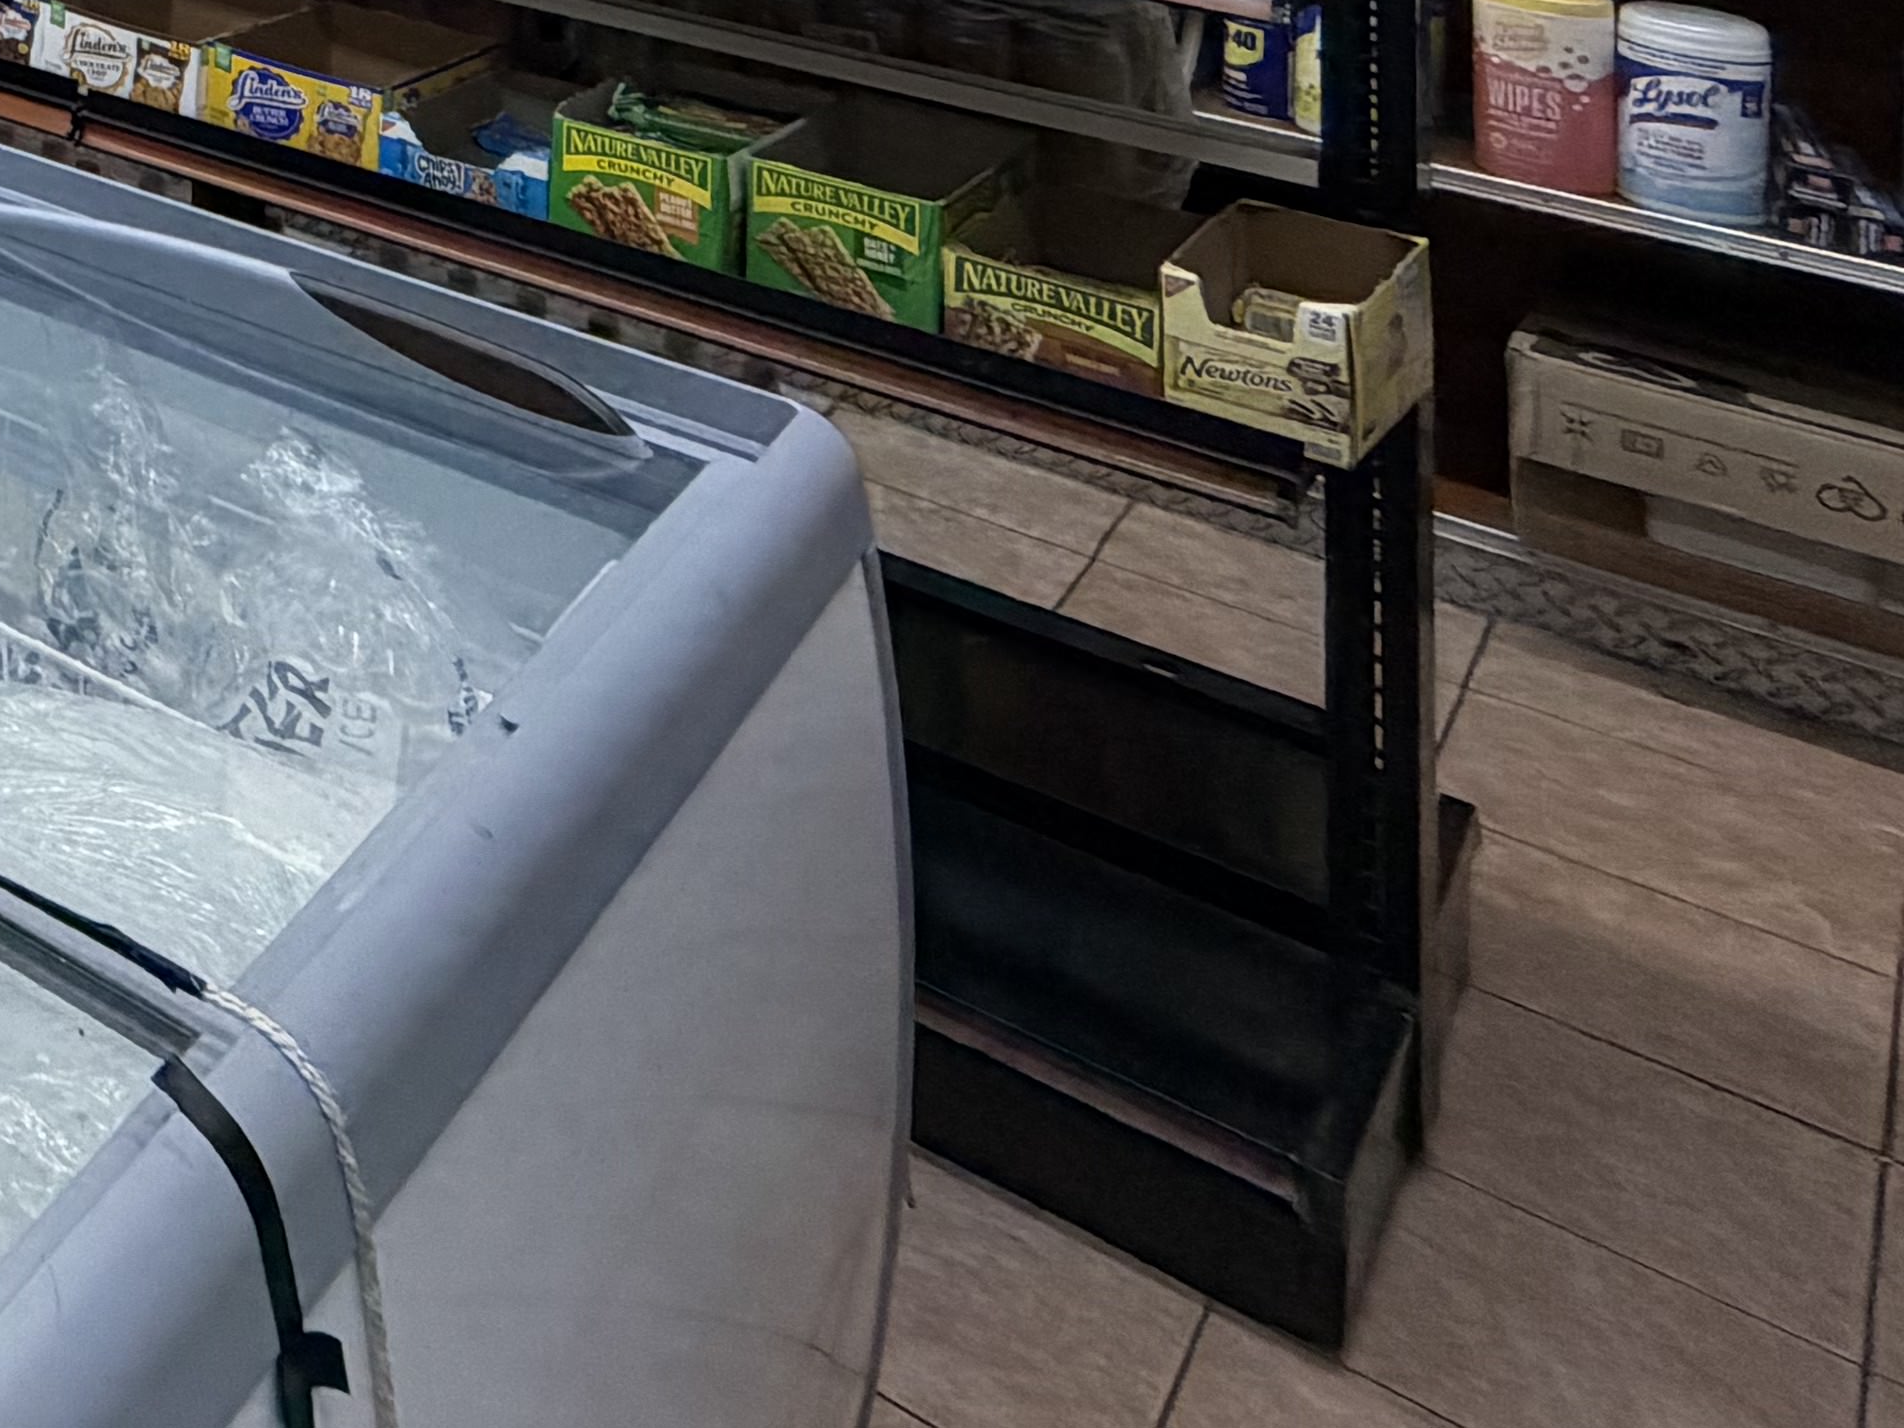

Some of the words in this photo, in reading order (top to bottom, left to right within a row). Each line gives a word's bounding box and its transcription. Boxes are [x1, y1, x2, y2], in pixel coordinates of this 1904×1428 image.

[67, 25, 133, 58] Linden's
[227, 69, 309, 111] Linden's
[348, 84, 374, 101] 18
[1490, 83, 1563, 121] WIPES
[1632, 79, 1719, 115] Lysol
[569, 128, 641, 164] NATURE
[639, 146, 705, 185] VALLEY
[596, 158, 675, 189] CRUNCHY
[759, 168, 836, 204] NATURE
[837, 187, 914, 232] VALLEY
[789, 200, 879, 232] CRUNCHY
[960, 262, 1054, 302] NATURE
[1055, 289, 1152, 342] VALLEY
[1010, 300, 1095, 333] CRUNCHY
[1308, 310, 1335, 328] 24
[1179, 354, 1293, 394] Newtons
